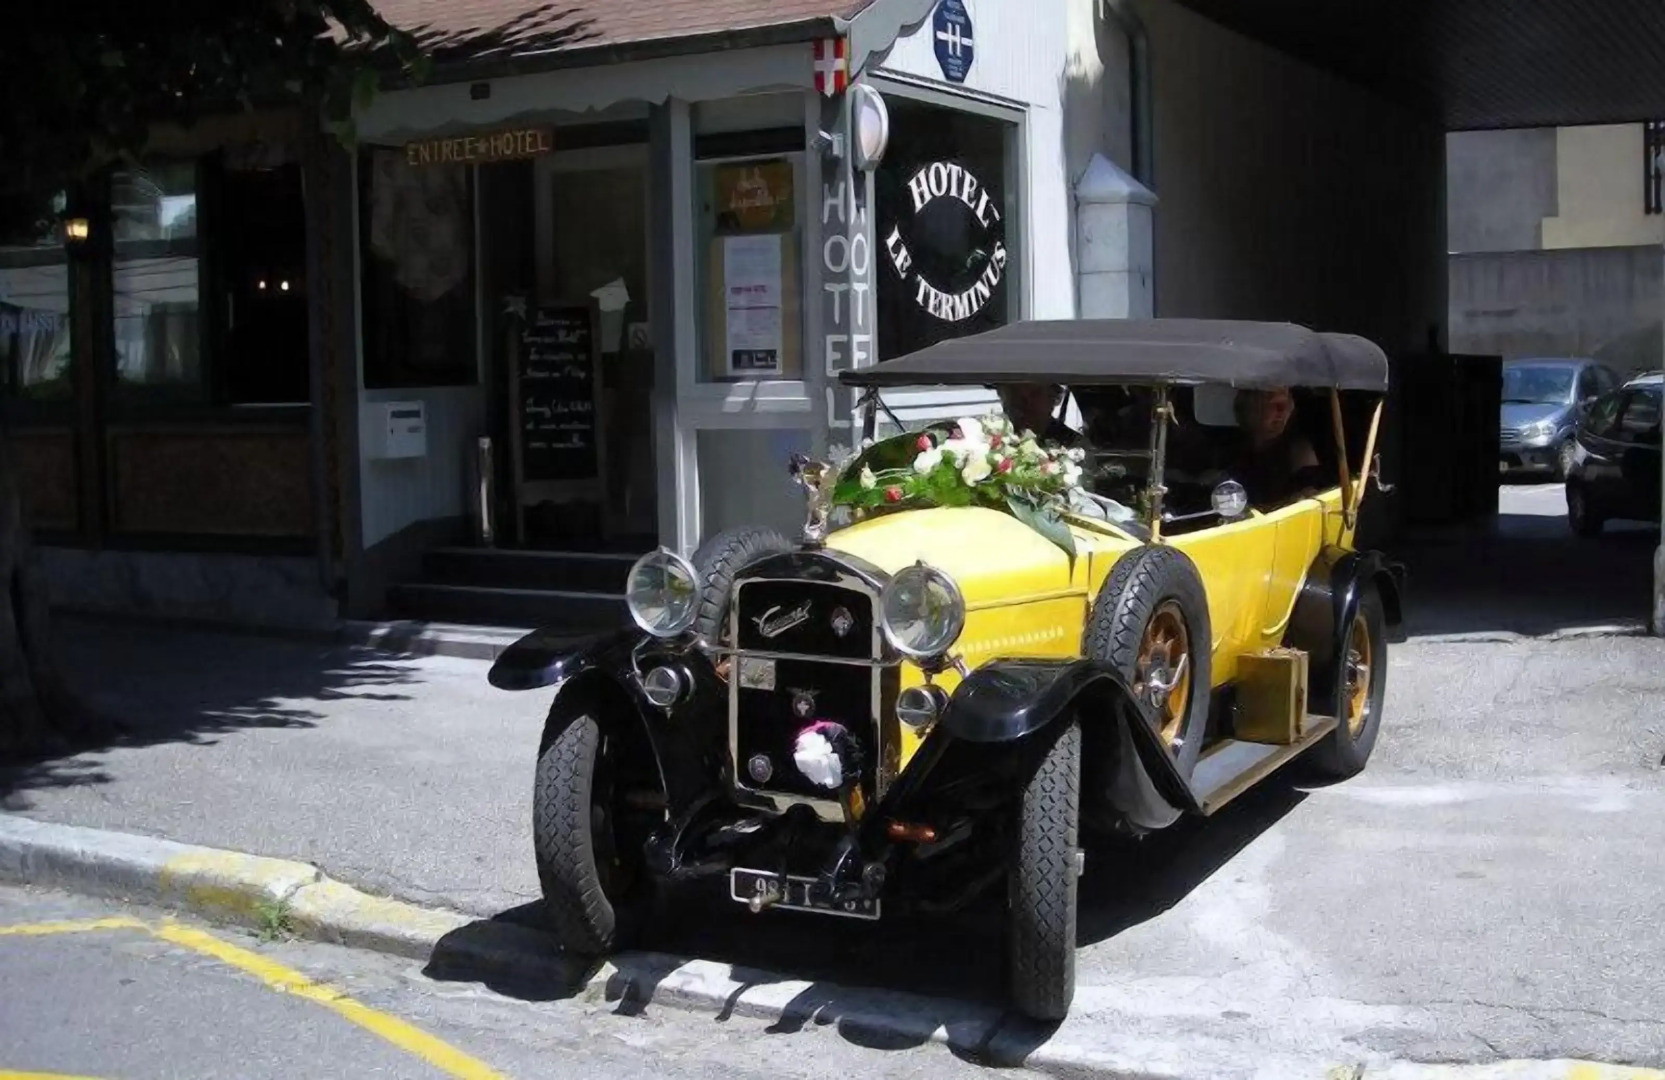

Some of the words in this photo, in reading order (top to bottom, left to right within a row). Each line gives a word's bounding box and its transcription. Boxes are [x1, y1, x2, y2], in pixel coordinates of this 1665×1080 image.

[490, 129, 550, 157] HOTEL
[908, 162, 1001, 228] HOTEL
[886, 224, 912, 280] LE
[915, 241, 1006, 322] TERMINUS
[823, 182, 851, 429] HOTEL
